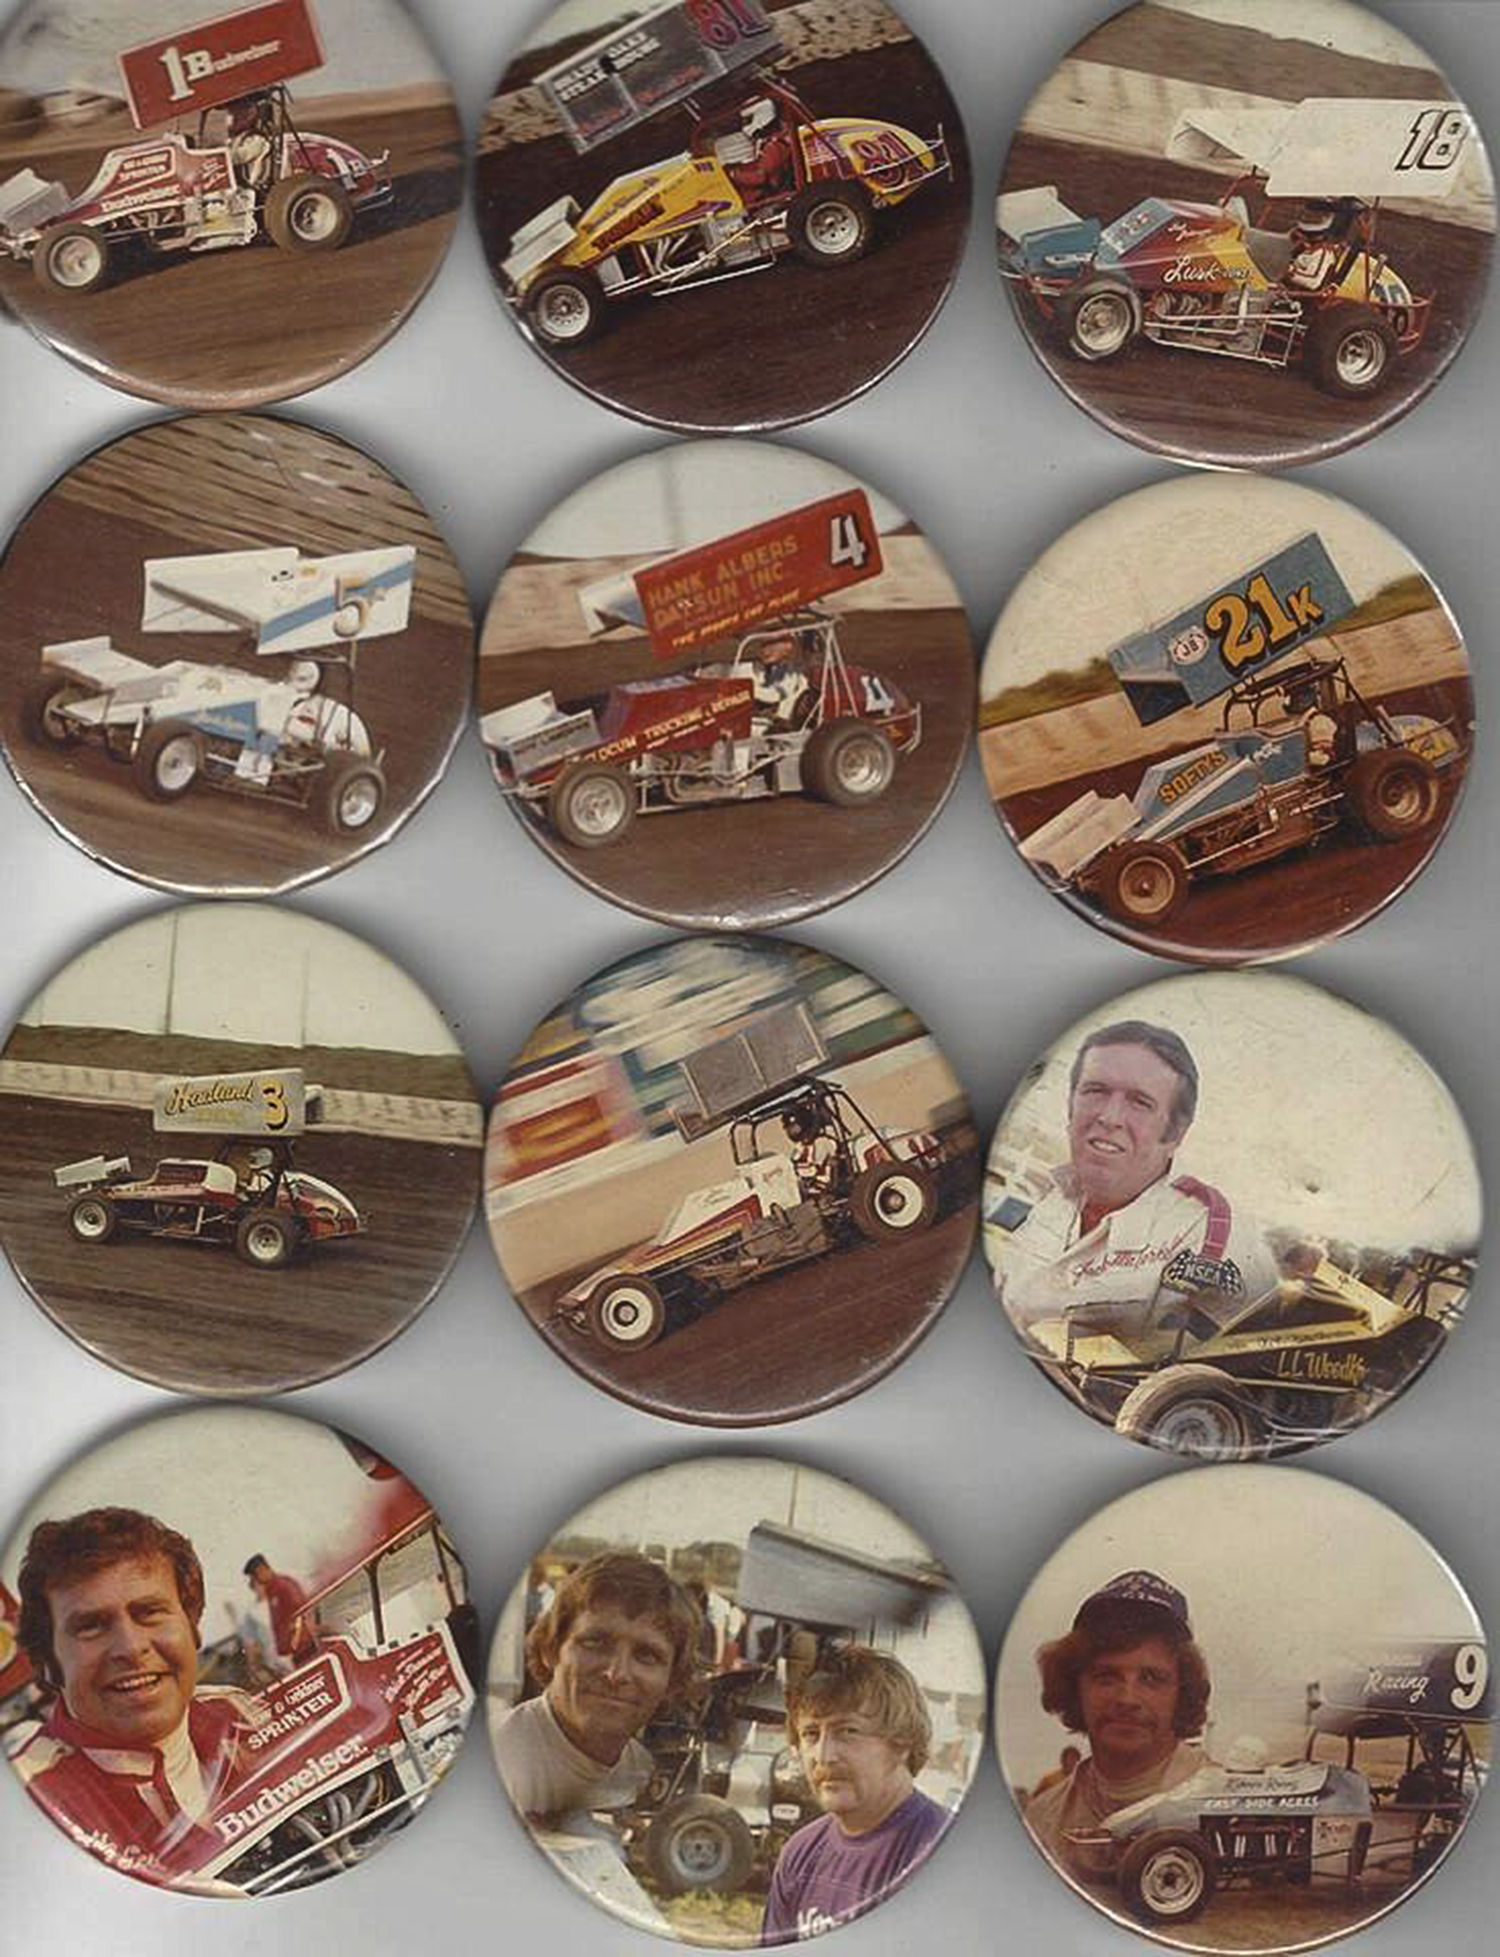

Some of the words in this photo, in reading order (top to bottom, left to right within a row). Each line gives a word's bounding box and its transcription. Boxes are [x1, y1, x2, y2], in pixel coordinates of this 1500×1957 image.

[1394, 108, 1468, 171] 18
[650, 570, 705, 607] HANK
[717, 534, 799, 581] ALBERS
[831, 513, 867, 567] 4
[749, 561, 784, 592] INC
[260, 1080, 289, 1131] 3
[1362, 1667, 1430, 1704] Racing
[1450, 1643, 1488, 1711] 9
[248, 1691, 334, 1751] SPRINTER
[214, 1735, 365, 1844] Budweiser
